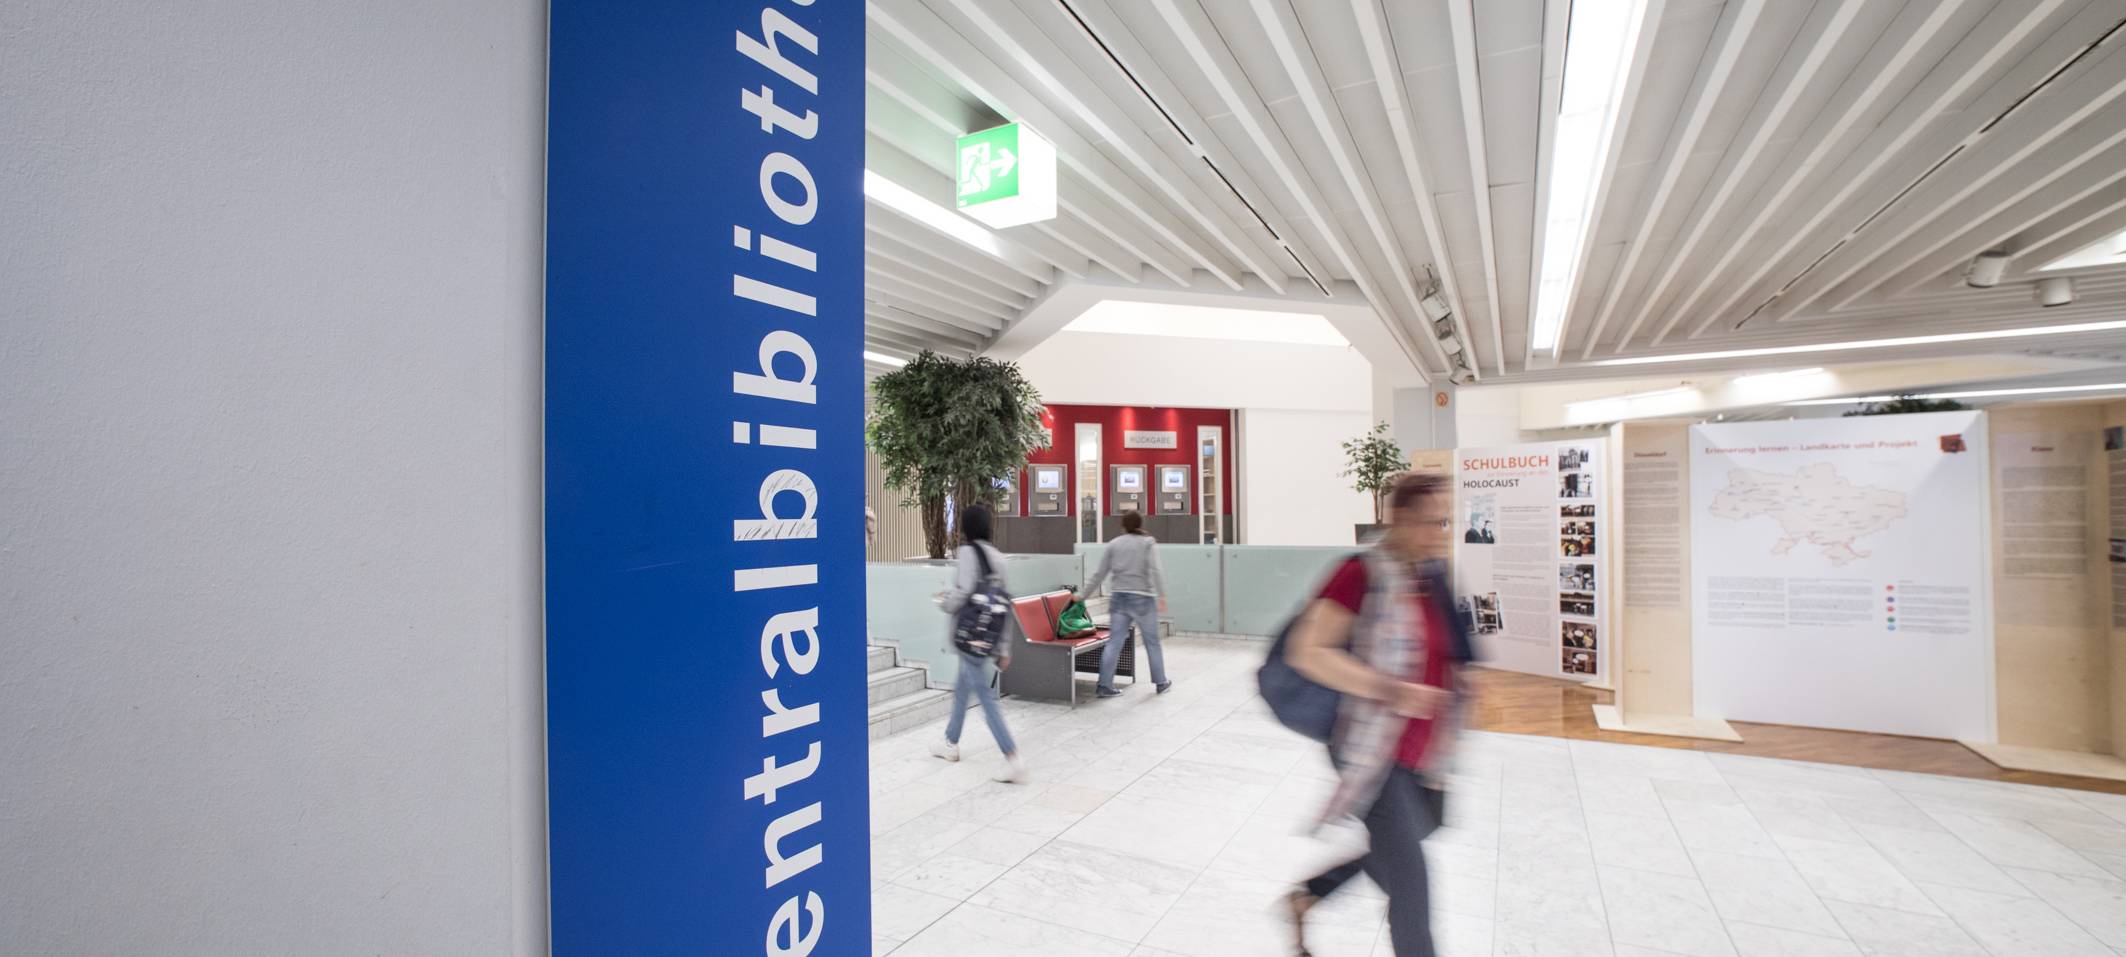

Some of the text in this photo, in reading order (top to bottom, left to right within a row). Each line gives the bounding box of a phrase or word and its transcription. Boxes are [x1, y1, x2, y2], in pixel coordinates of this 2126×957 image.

[1463, 455, 1549, 471] SCHULBUCH
[733, 0, 825, 957] entralbiblioth
[1463, 478, 1520, 488] HOLOCAUST
